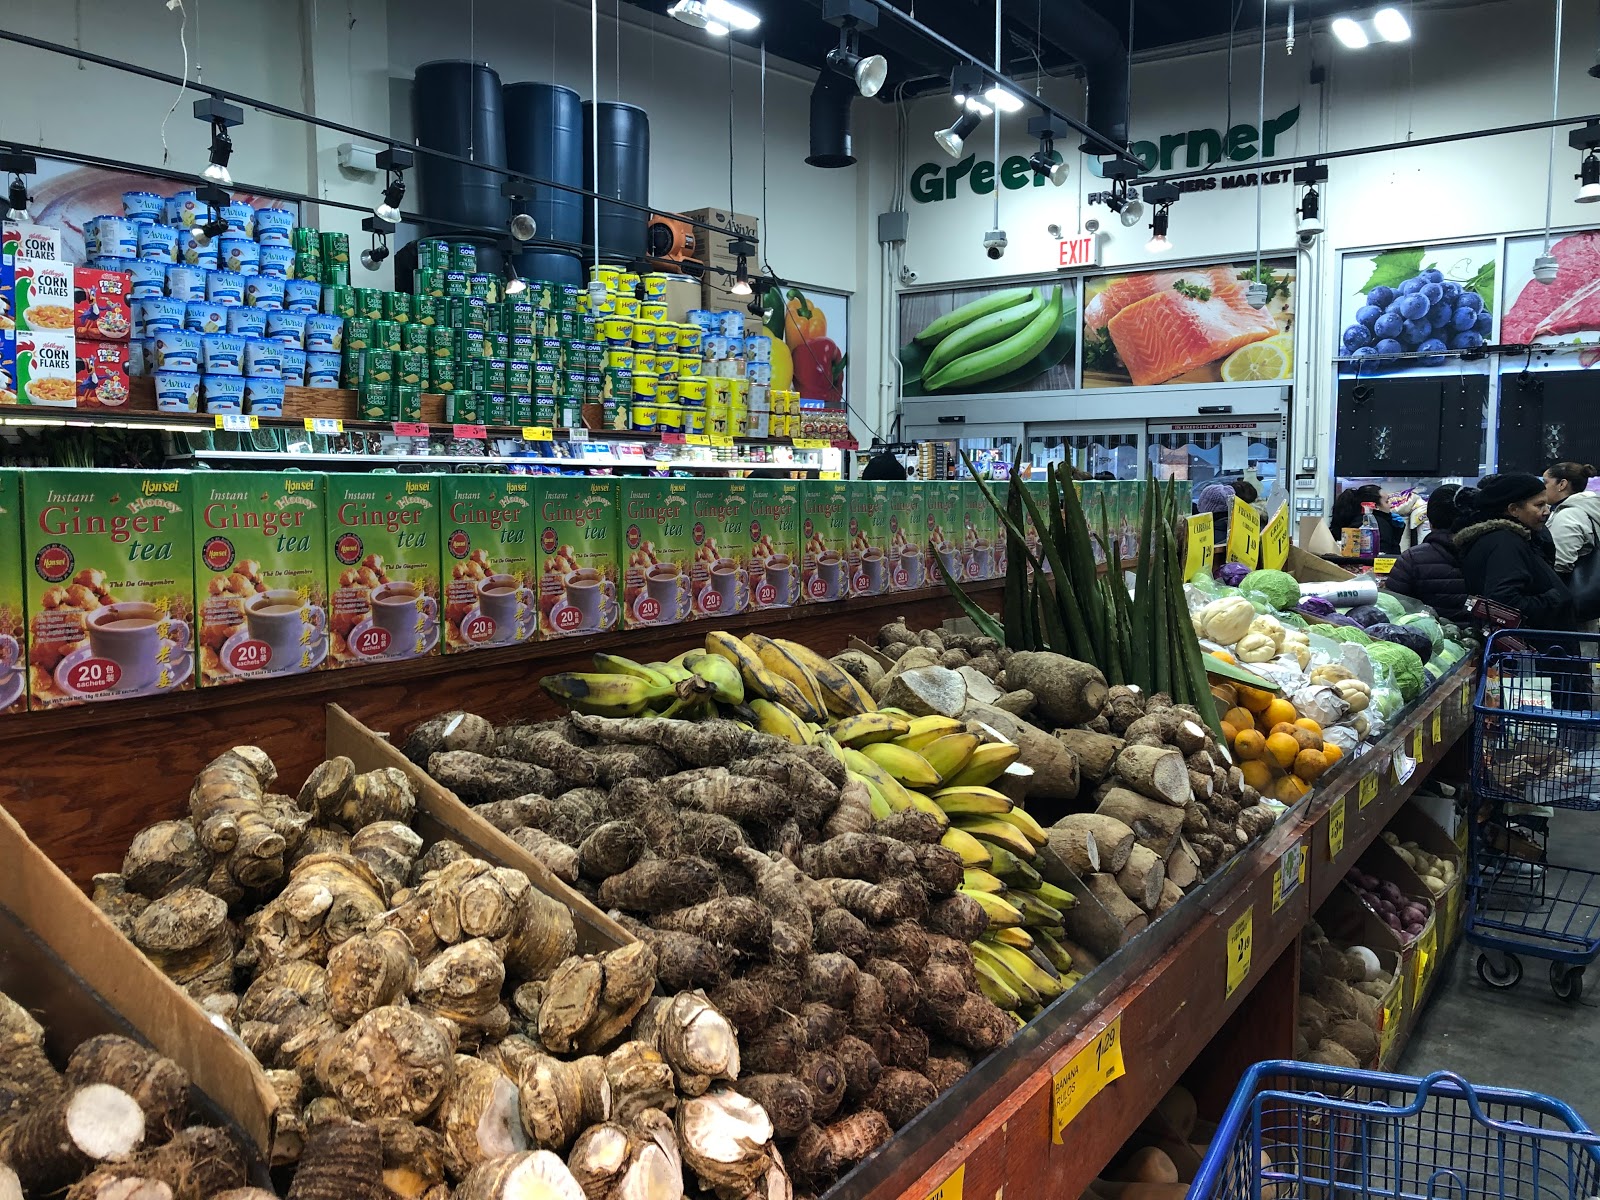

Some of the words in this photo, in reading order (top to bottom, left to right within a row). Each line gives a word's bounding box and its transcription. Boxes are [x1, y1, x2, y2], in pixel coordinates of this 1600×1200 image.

[1170, 177, 1217, 194] MERS
[1221, 169, 1292, 189] MARKET
[223, 208, 247, 218] Aviva
[269, 216, 291, 225] Aviva
[147, 231, 172, 241] Aviva
[25, 239, 54, 252] CORN
[1059, 238, 1091, 265] EXIT
[26, 250, 55, 261] FLAKES
[266, 252, 288, 261] Aviva
[41, 269, 64, 277] Kellogg's
[38, 275, 68, 288] CORN
[99, 280, 123, 289] FROOT
[222, 277, 243, 288] Aviva
[38, 286, 68, 297] FLAKES
[101, 287, 122, 295] LOOPS
[159, 305, 182, 316] Aviva
[281, 318, 302, 327] Aviva
[312, 322, 335, 331] Aviva
[43, 342, 66, 350] Kellogg's
[217, 341, 240, 351] Aviva
[39, 348, 69, 360] CORN
[97, 349, 121, 357] FROOT
[40, 359, 70, 369] FLAKES
[165, 379, 190, 388] Aviva
[220, 383, 242, 392] Aviva
[141, 480, 179, 496] Honsei
[285, 479, 314, 494] Honsei
[406, 481, 430, 495] Honsei
[506, 482, 527, 494] Honsei
[590, 483, 609, 494] Honsei
[47, 490, 95, 502] Instant
[210, 489, 248, 500] Instant
[344, 489, 375, 500] Instant
[454, 490, 480, 499] Instant
[545, 491, 568, 499] Instant
[126, 497, 183, 514] Honey
[274, 495, 318, 510] Honey
[804, 499, 842, 518] Ginger
[450, 502, 521, 530] Ginger
[542, 501, 602, 527] Ginger
[628, 501, 680, 525] Ginger
[694, 501, 740, 522] Ginger
[750, 500, 792, 520] Ginger
[204, 503, 304, 536] Ginger
[338, 502, 422, 533] Ginger
[39, 506, 165, 543] Ginger
[665, 522, 684, 537] tea
[725, 520, 743, 533] tea
[501, 528, 525, 544] tea
[585, 525, 607, 540] tea
[277, 534, 311, 553] tea
[398, 531, 427, 548] tea
[128, 540, 172, 562] tea
[813, 583, 822, 591] 20
[706, 594, 716, 605] 20
[762, 589, 770, 598] 20
[642, 604, 653, 613] 20
[561, 611, 573, 623] 20
[473, 621, 486, 634] 20
[363, 633, 378, 646] 20
[238, 645, 257, 661] 20
[78, 665, 101, 682] 20
[76, 680, 106, 688] sachets
[1055, 1065, 1079, 1094] BANANA
[1057, 1082, 1075, 1108] RULOS
